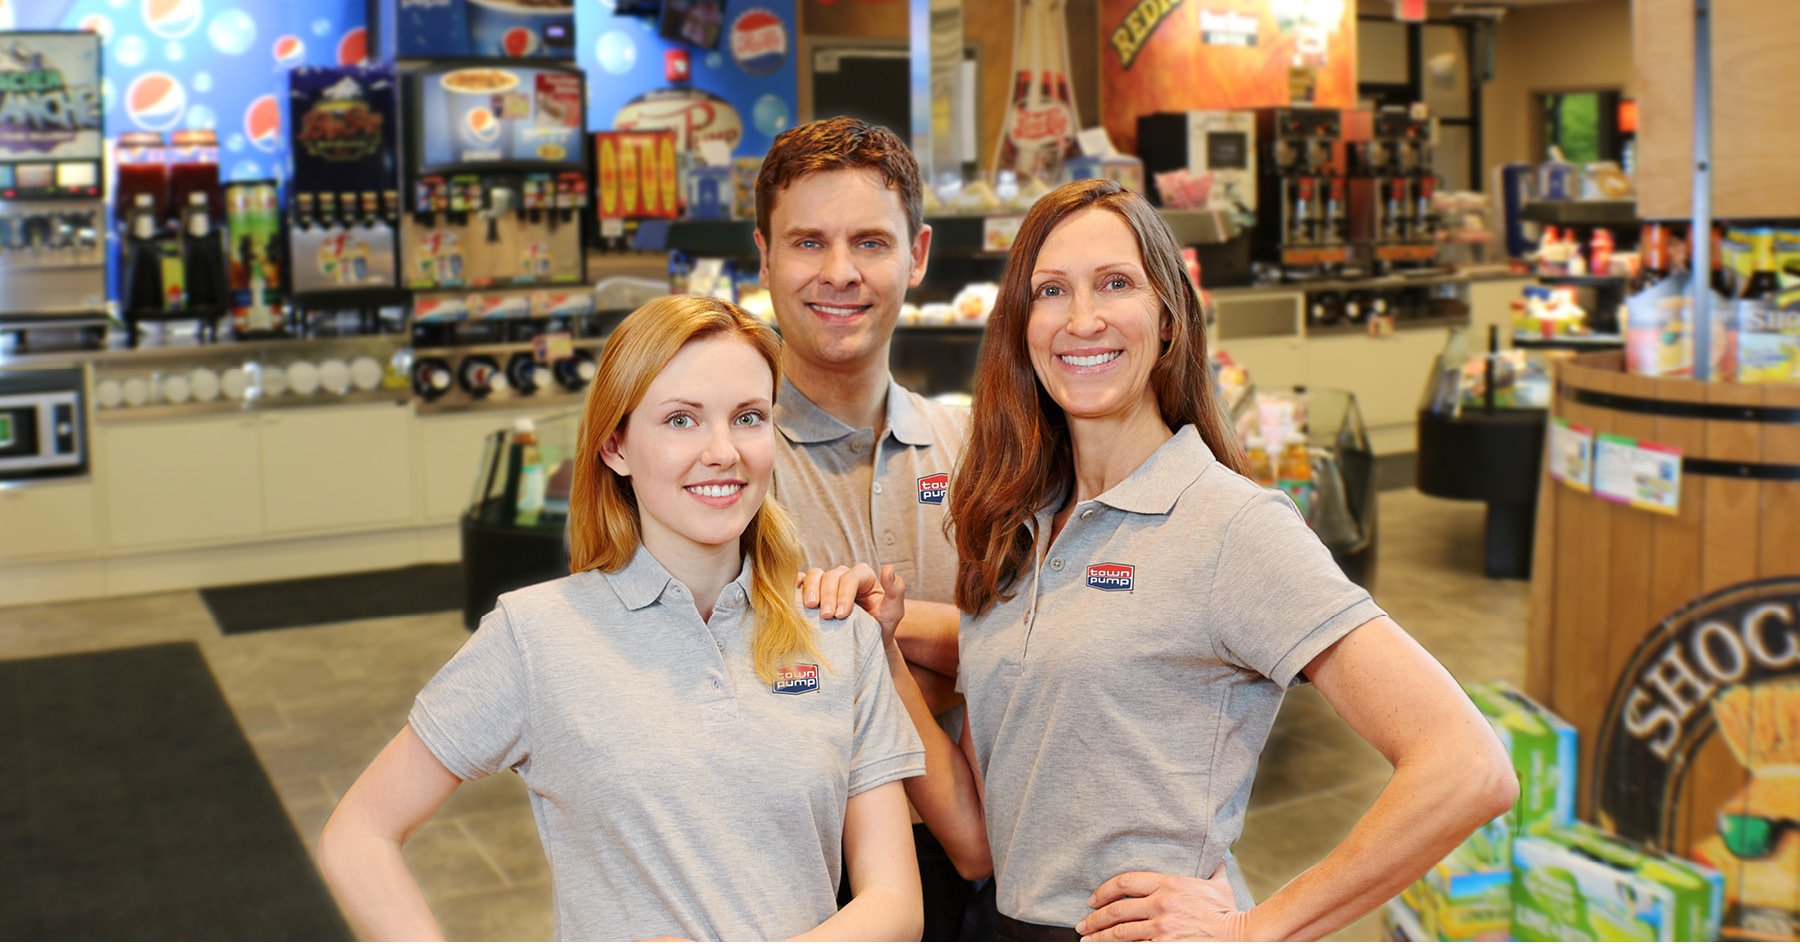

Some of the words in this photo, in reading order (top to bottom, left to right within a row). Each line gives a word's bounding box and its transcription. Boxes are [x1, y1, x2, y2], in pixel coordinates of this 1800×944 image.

[0, 89, 101, 129] ANCHE
[923, 490, 947, 500] pu
[1090, 569, 1130, 577] town
[1090, 577, 1130, 587] pump
[777, 678, 816, 689] pump
[1623, 603, 1800, 758] SHOC
